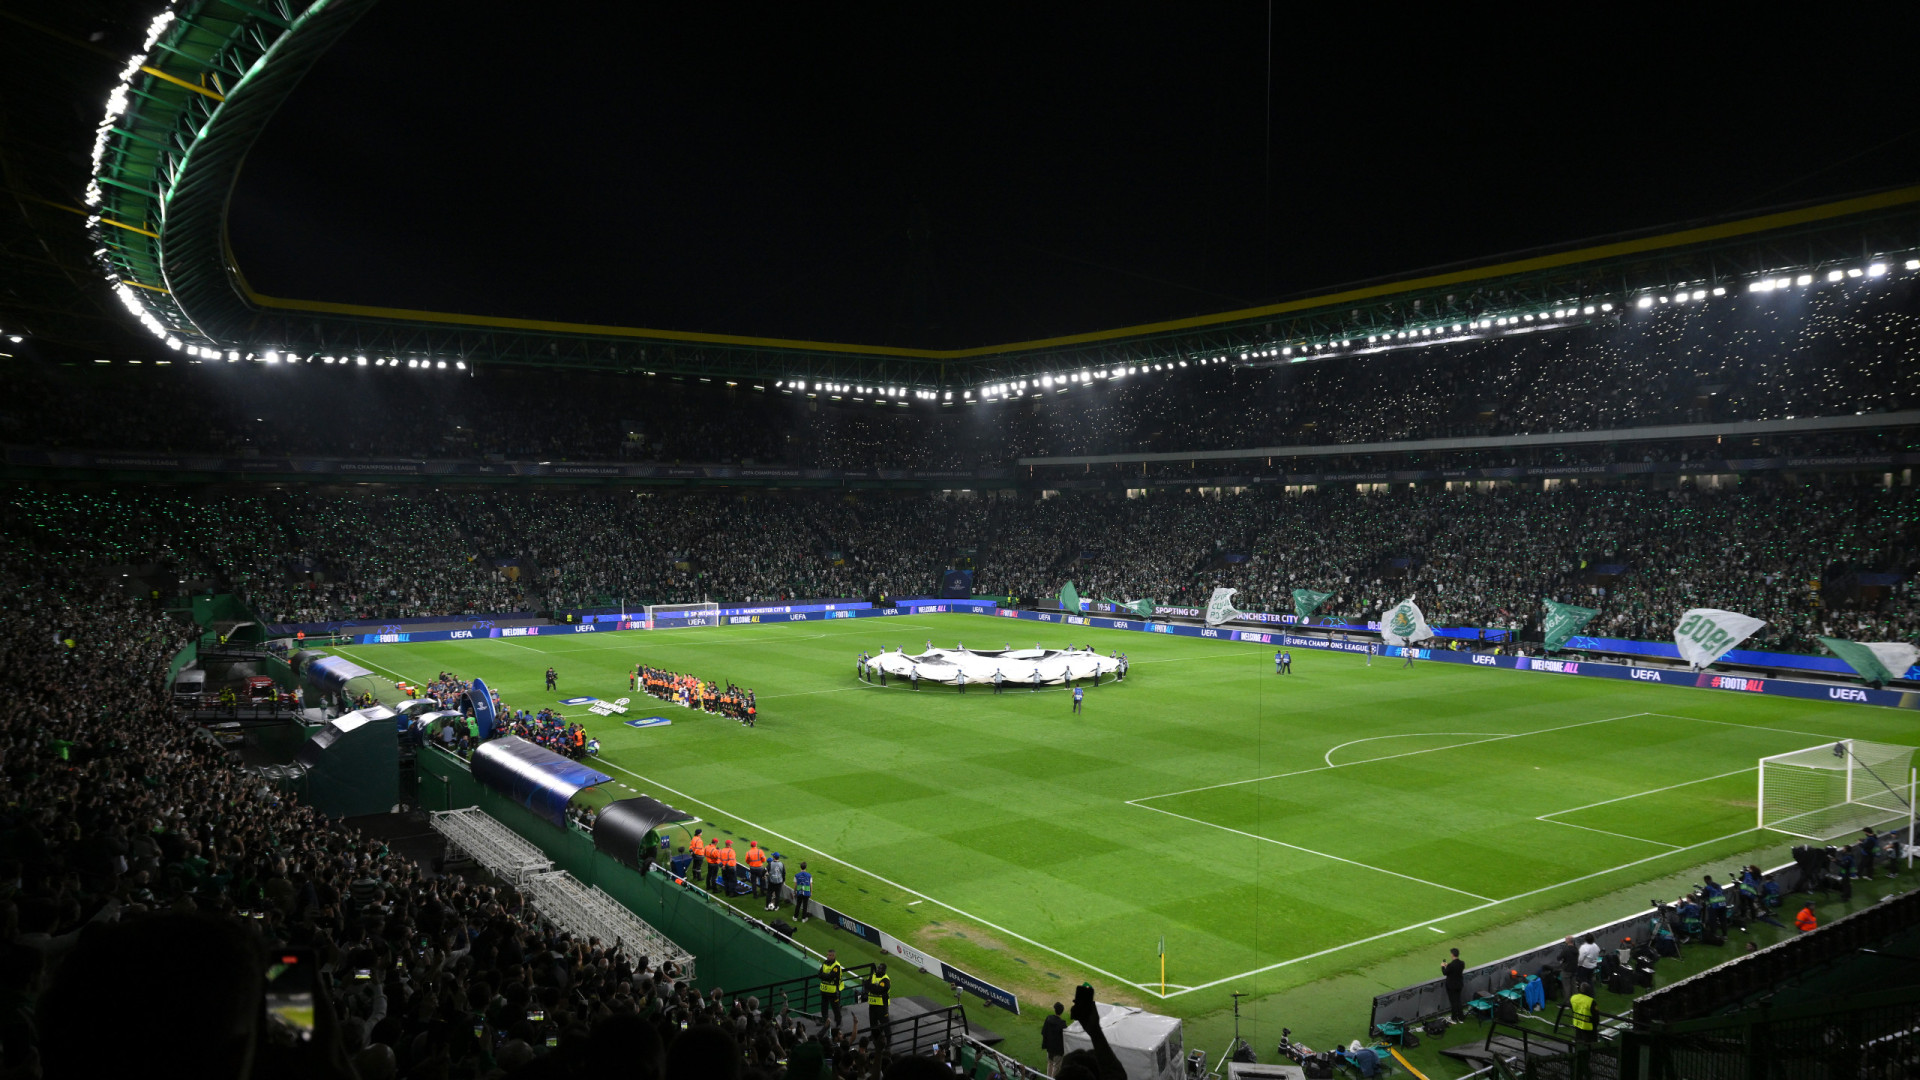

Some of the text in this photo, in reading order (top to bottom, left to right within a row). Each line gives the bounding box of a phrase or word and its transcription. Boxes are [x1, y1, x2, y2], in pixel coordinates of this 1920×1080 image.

[1810, 457, 1858, 465] CHAMPIONS
[1859, 455, 1892, 464] LEAGUE
[918, 605, 937, 613] WELCOME
[1097, 603, 1111, 611] 19:56
[687, 618, 706, 626] UEFA
[729, 615, 761, 624] WELCOME ALL
[1067, 616, 1091, 626] WELCOME ALL
[1235, 612, 1280, 623] ANCHESTER
[1281, 614, 1298, 624] CITY
[1113, 620, 1128, 629] UEFA
[1150, 624, 1175, 634] #FOOTBALL
[450, 630, 473, 639] UEFA
[502, 627, 539, 636] WELCOME ALL
[1201, 629, 1218, 638] UEFA
[373, 633, 410, 643] #FOOTBALL
[1240, 632, 1271, 643] WELCOME ALL
[1292, 637, 1307, 646] UEFA
[1308, 640, 1343, 650] CHAMPONS
[1472, 654, 1496, 666] UEFA
[1531, 659, 1579, 674] WELCOME ALL
[1630, 669, 1661, 682] UEFA
[1711, 676, 1764, 692] #FOOTBALL
[1829, 687, 1868, 702] UEFA
[902, 948, 924, 965] RESPECT
[947, 970, 1011, 1006] UEFA CHAMPIONS LEAGUE
